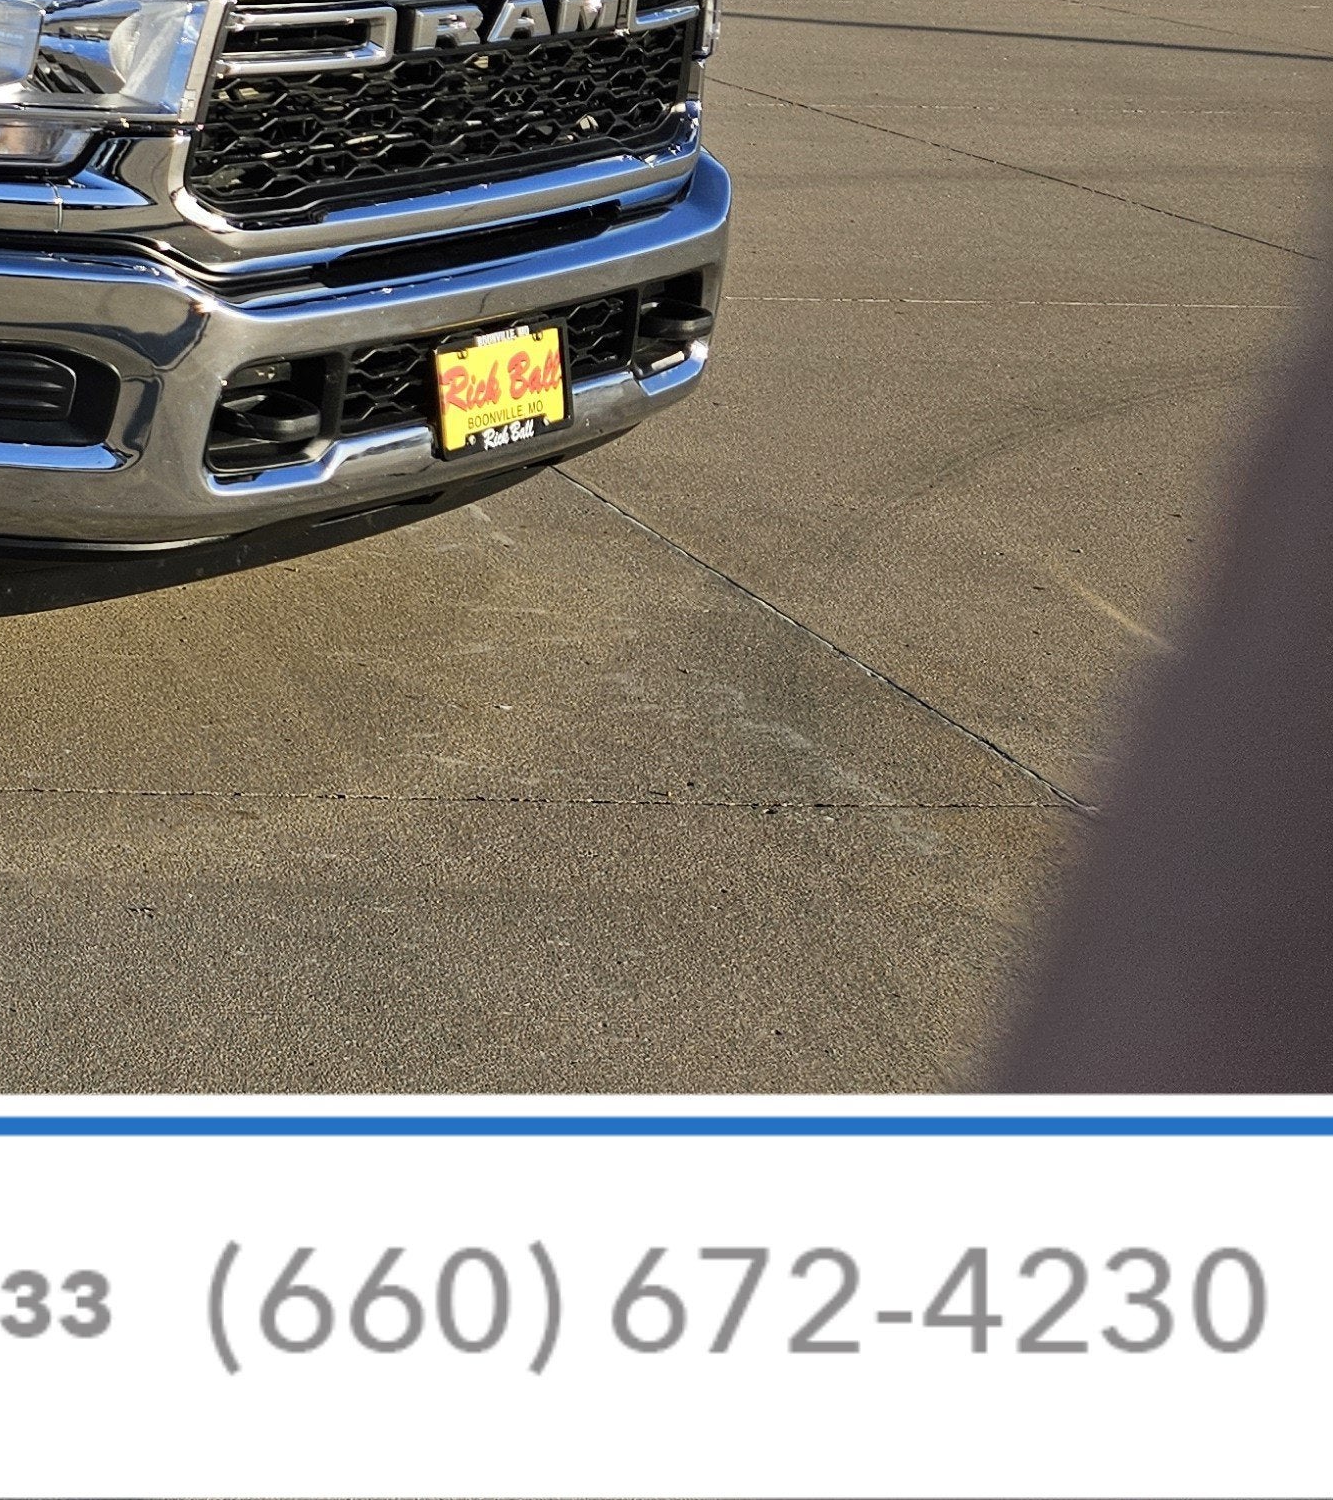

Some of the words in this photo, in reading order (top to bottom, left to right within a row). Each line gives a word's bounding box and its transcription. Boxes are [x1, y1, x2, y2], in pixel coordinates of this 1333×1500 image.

[476, 329, 515, 347] BOONVILLE
[439, 360, 502, 415] Rick
[507, 349, 562, 400] Ball
[528, 399, 544, 415] MO
[482, 427, 511, 450] Rick
[510, 418, 535, 442] Ball
